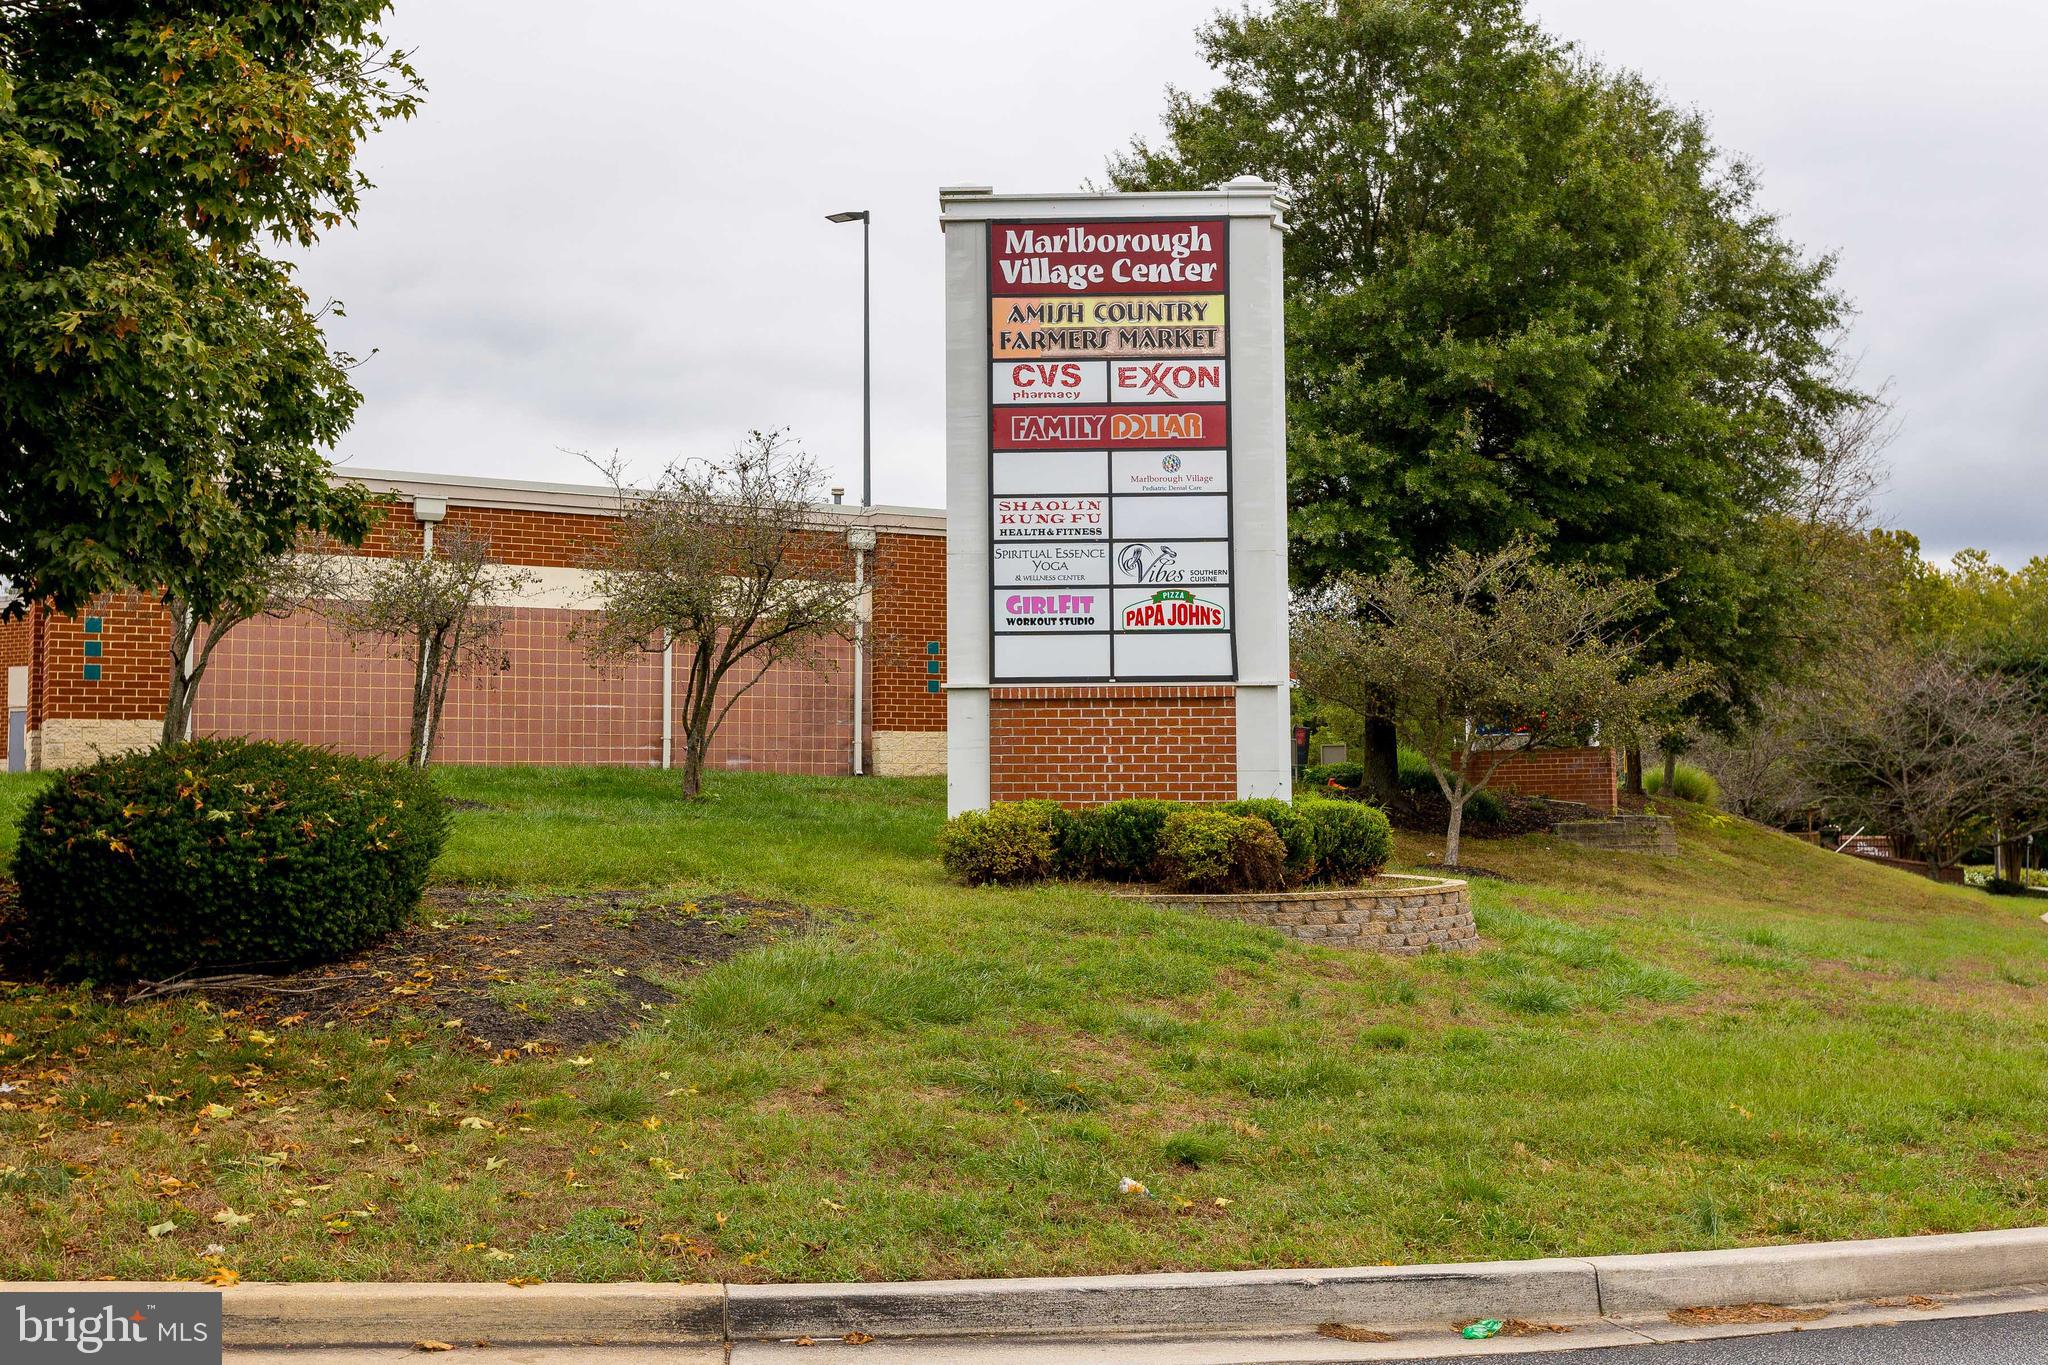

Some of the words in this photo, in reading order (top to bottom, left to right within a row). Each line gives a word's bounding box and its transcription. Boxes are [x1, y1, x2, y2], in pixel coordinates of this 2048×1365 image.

[1005, 226, 1211, 258] Marlborough
[999, 258, 1104, 289] Village
[1112, 259, 1217, 283] Center
[1008, 303, 1084, 323] AMISH
[1094, 302, 1208, 323] COUNTRY
[1000, 330, 1110, 350] FARMERS
[1119, 329, 1218, 348] MARKET
[1012, 364, 1082, 387] CVS
[1118, 363, 1220, 398] EXXON
[1013, 390, 1080, 400] pharmacy
[1012, 415, 1107, 441] FAMILY
[1111, 413, 1202, 440] DOLLAR
[1131, 475, 1183, 483] Marlborough
[1186, 474, 1213, 483] Village
[999, 501, 1101, 511] SHAOLIN
[1000, 514, 1065, 524] KUNG
[1071, 514, 1101, 524] FU
[995, 547, 1052, 560] SPIRITUAL
[1055, 548, 1105, 558] ESSENCE
[1122, 544, 1184, 584] Vibes
[1032, 560, 1068, 572] YOGA
[1006, 595, 1094, 615] GIRLFIT
[1126, 605, 1164, 627] PAPA
[1168, 604, 1221, 626] JOHN'S
[1007, 617, 1058, 625] WORKOUT
[1059, 617, 1094, 625] STUDIO
